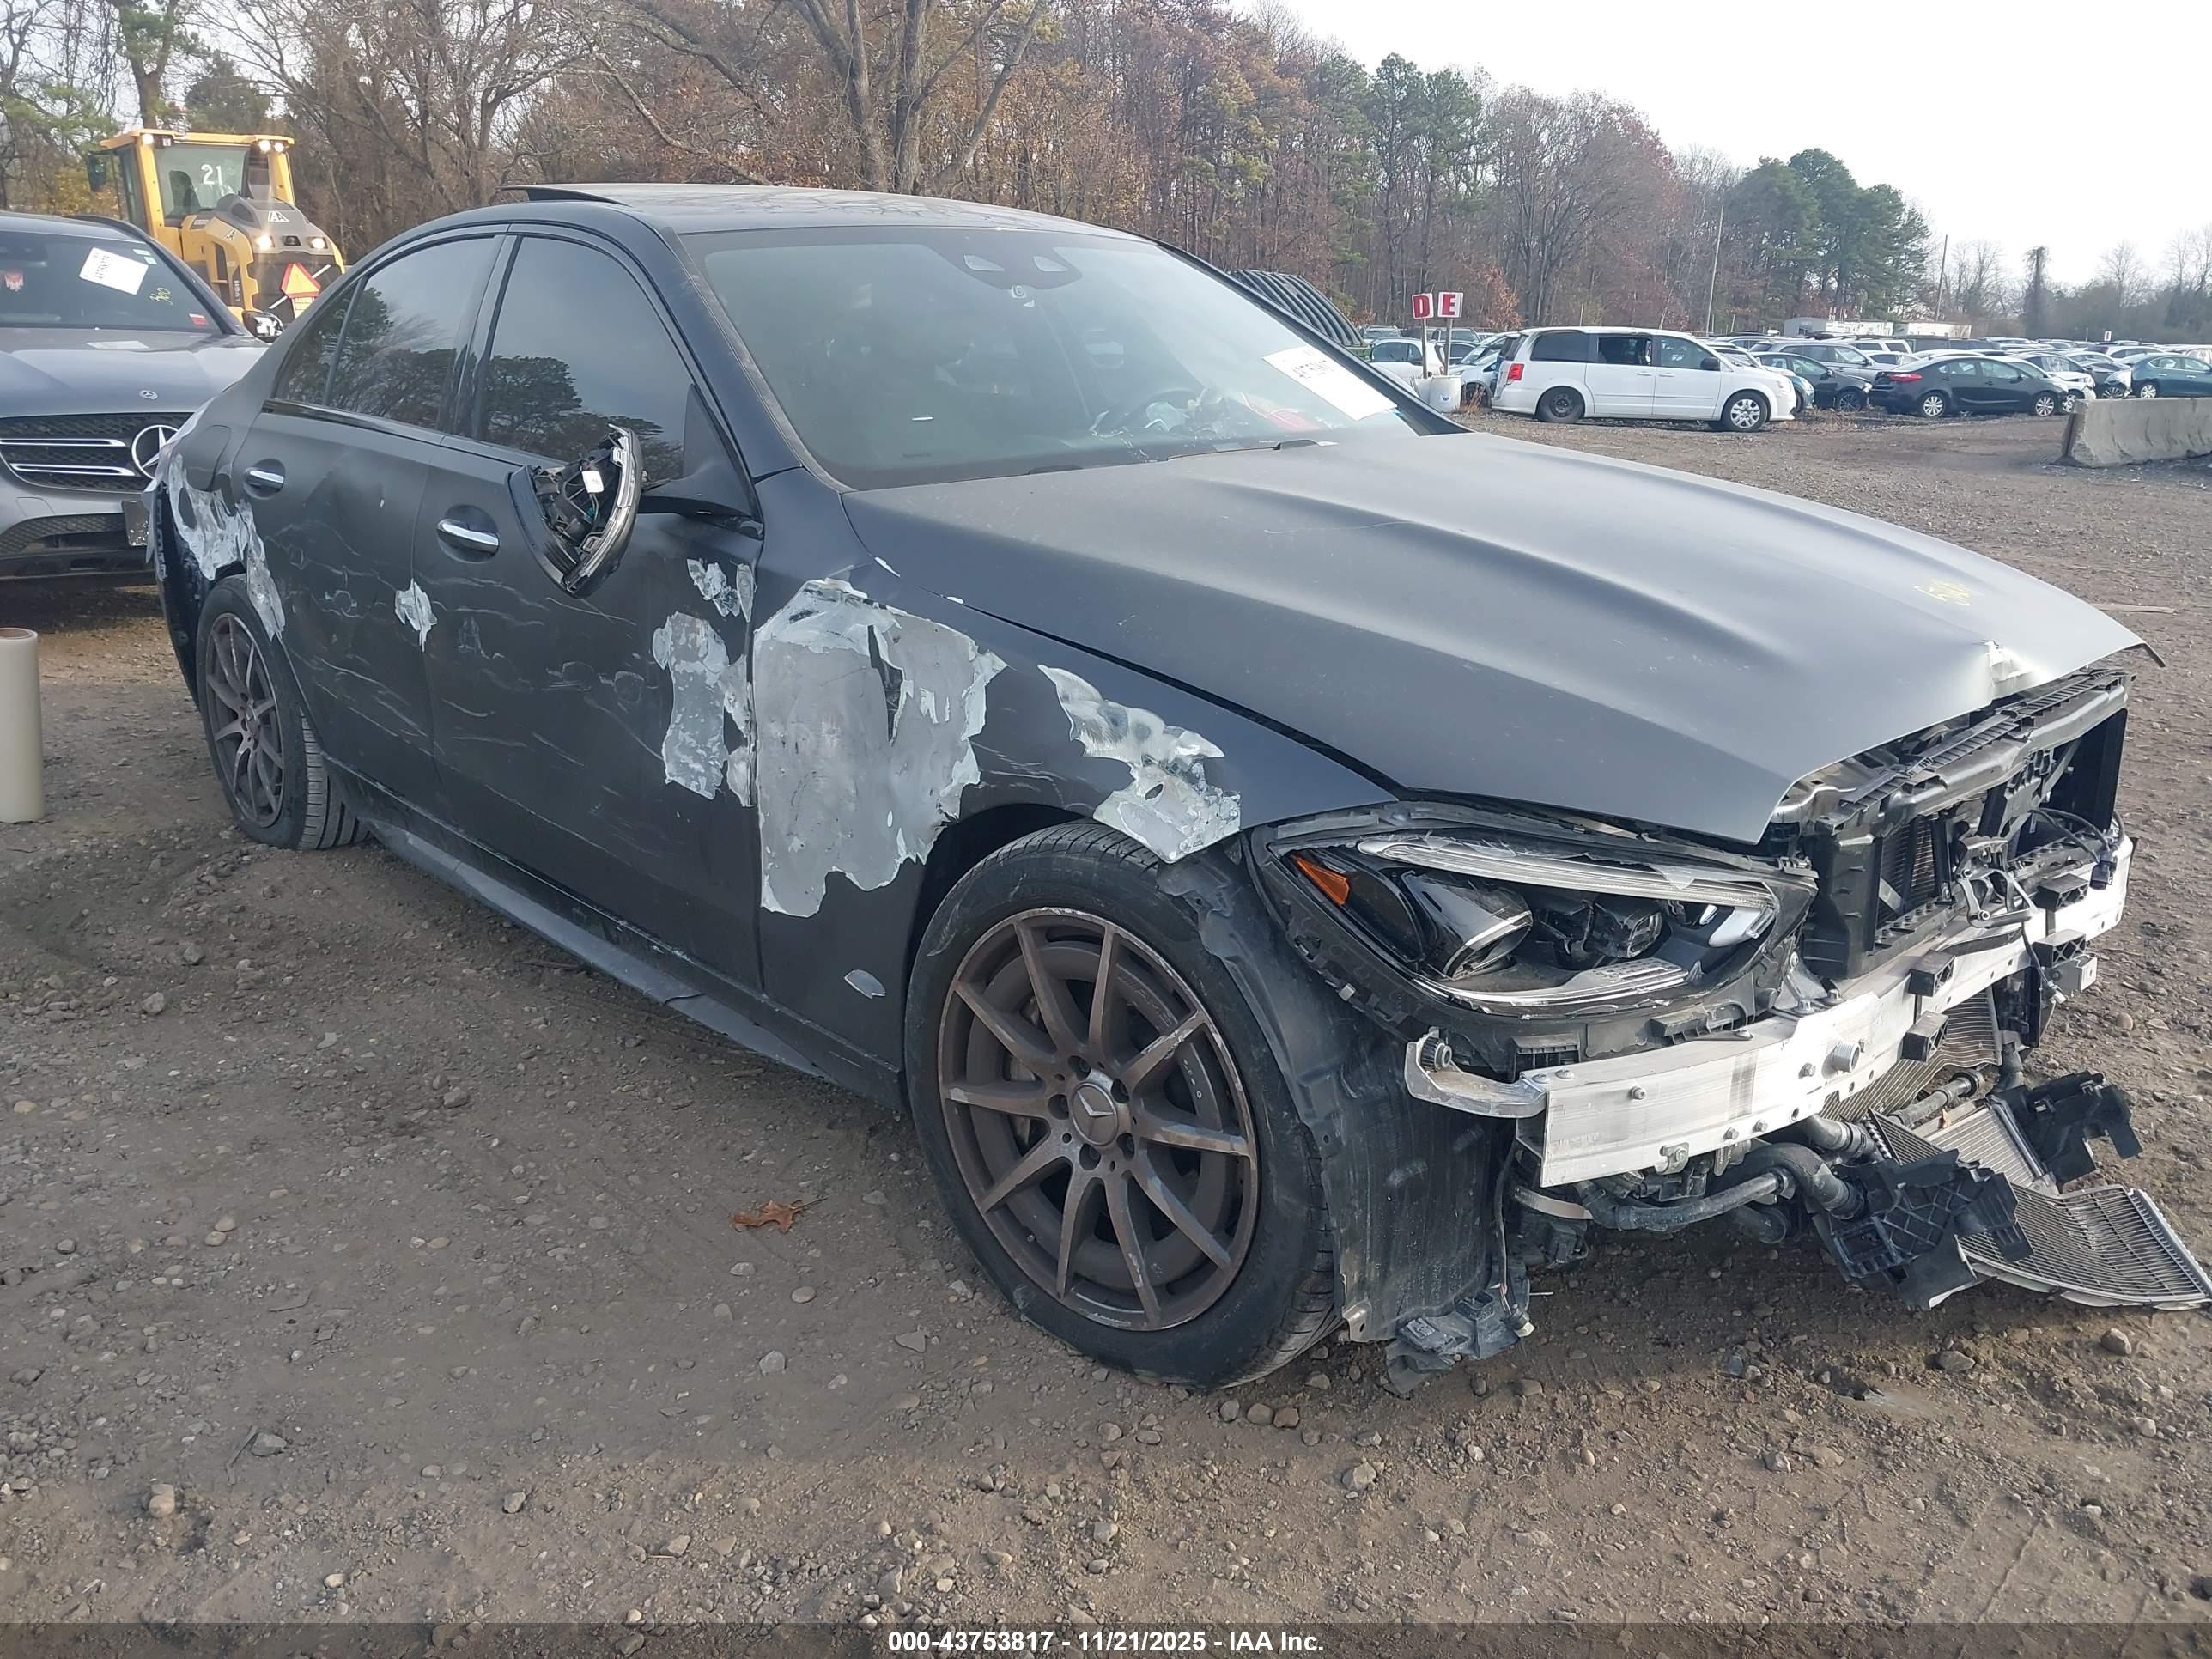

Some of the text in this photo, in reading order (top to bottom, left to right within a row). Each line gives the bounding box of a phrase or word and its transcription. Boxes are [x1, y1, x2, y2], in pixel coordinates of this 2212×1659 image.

[200, 163, 223, 185] 21
[1413, 295, 1431, 319] D
[1441, 294, 1457, 316] E
